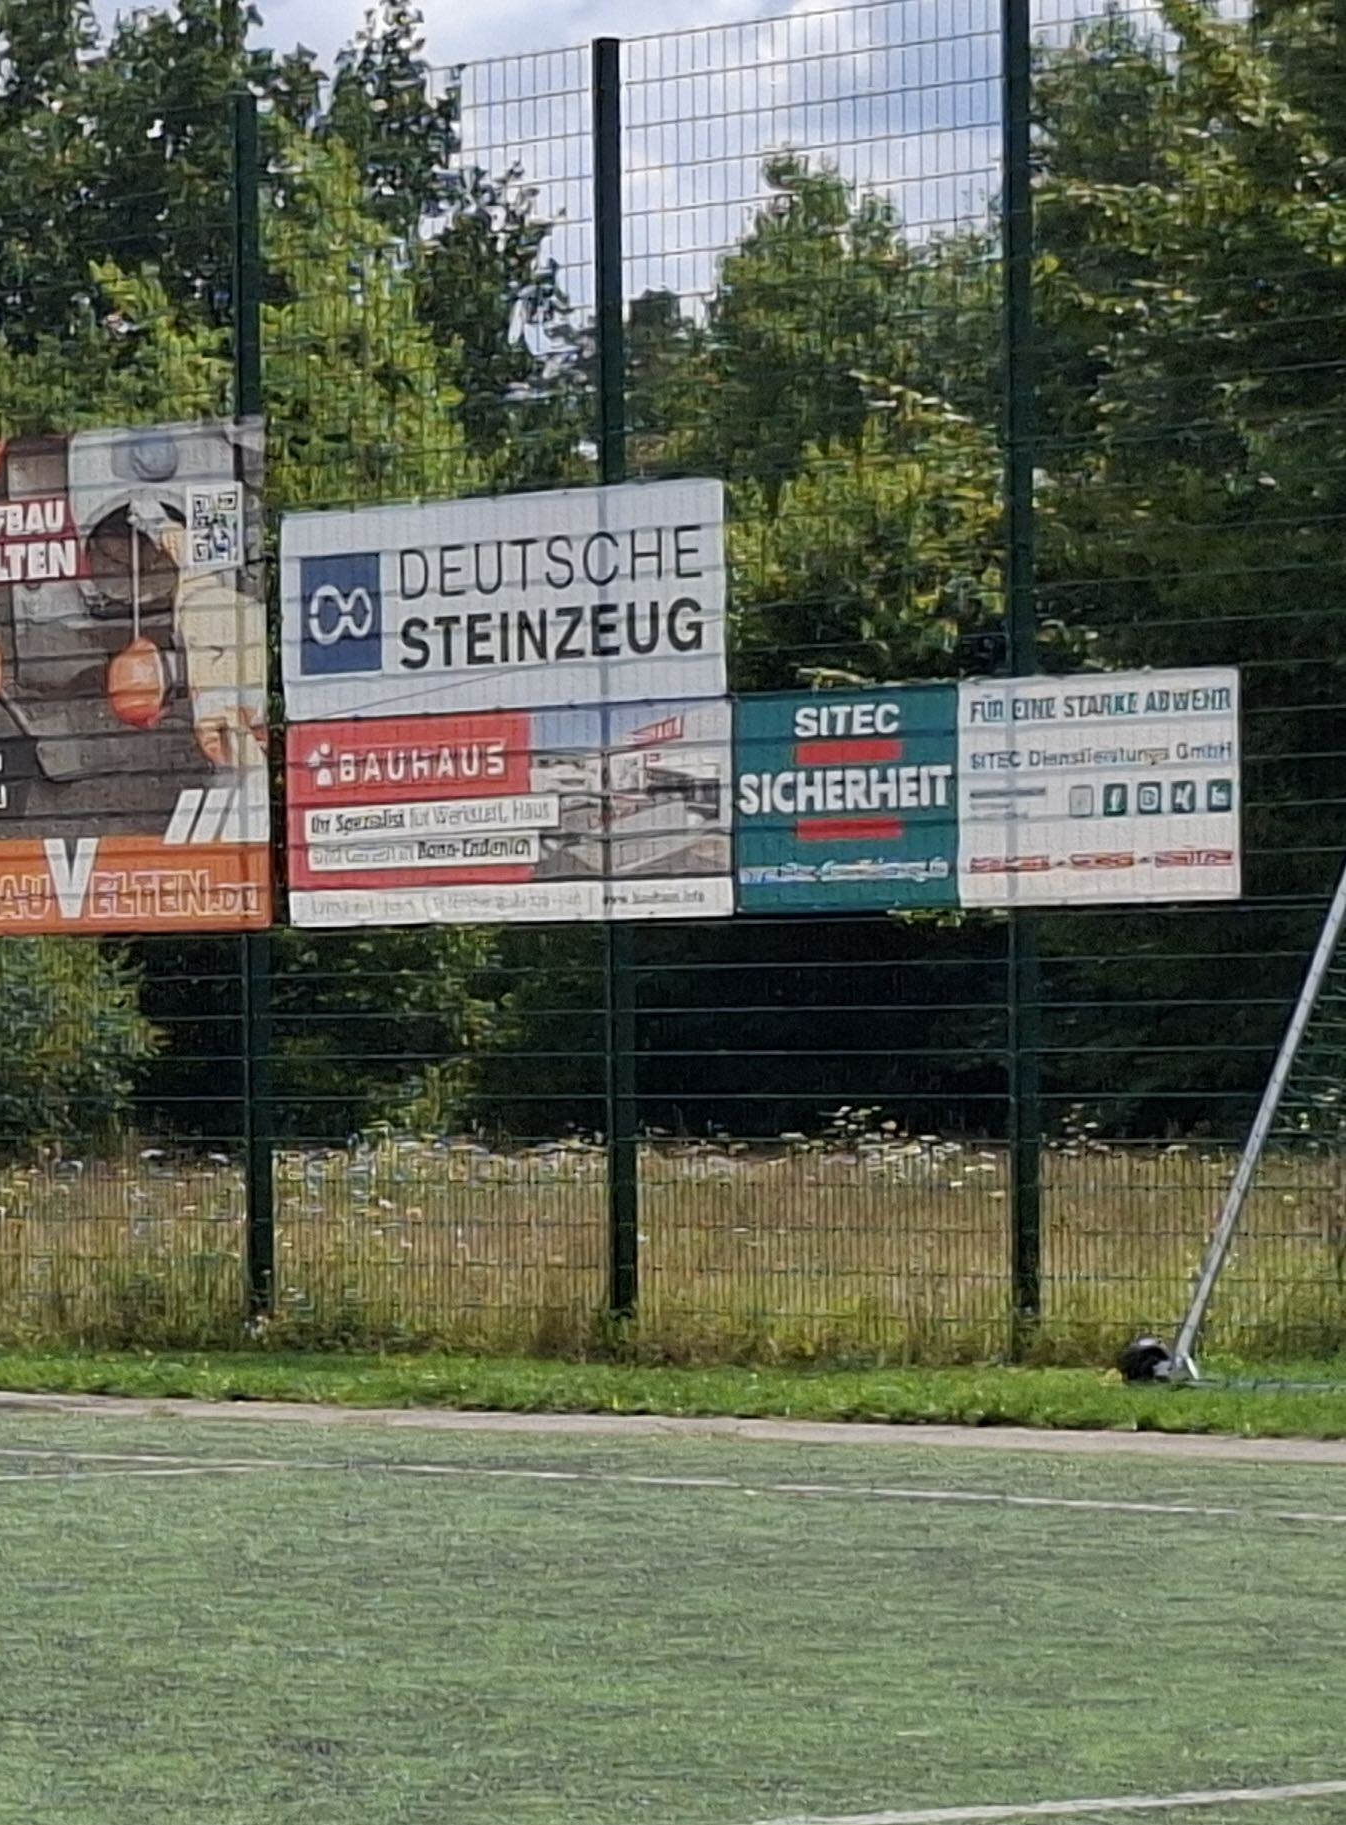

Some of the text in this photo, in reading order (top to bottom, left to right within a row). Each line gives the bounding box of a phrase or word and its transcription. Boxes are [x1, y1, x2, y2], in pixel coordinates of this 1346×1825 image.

[400, 524, 702, 601] DEUTSCHE
[400, 597, 704, 670] STEINZEUG
[794, 703, 900, 737] SITEC
[970, 687, 1231, 723] FÜR EINE STARKE ABWEHR
[339, 743, 506, 782] BAUHAUS
[971, 750, 1021, 769] SITEC
[1176, 741, 1232, 760] GmbH
[738, 764, 952, 815] SICHERHEIT
